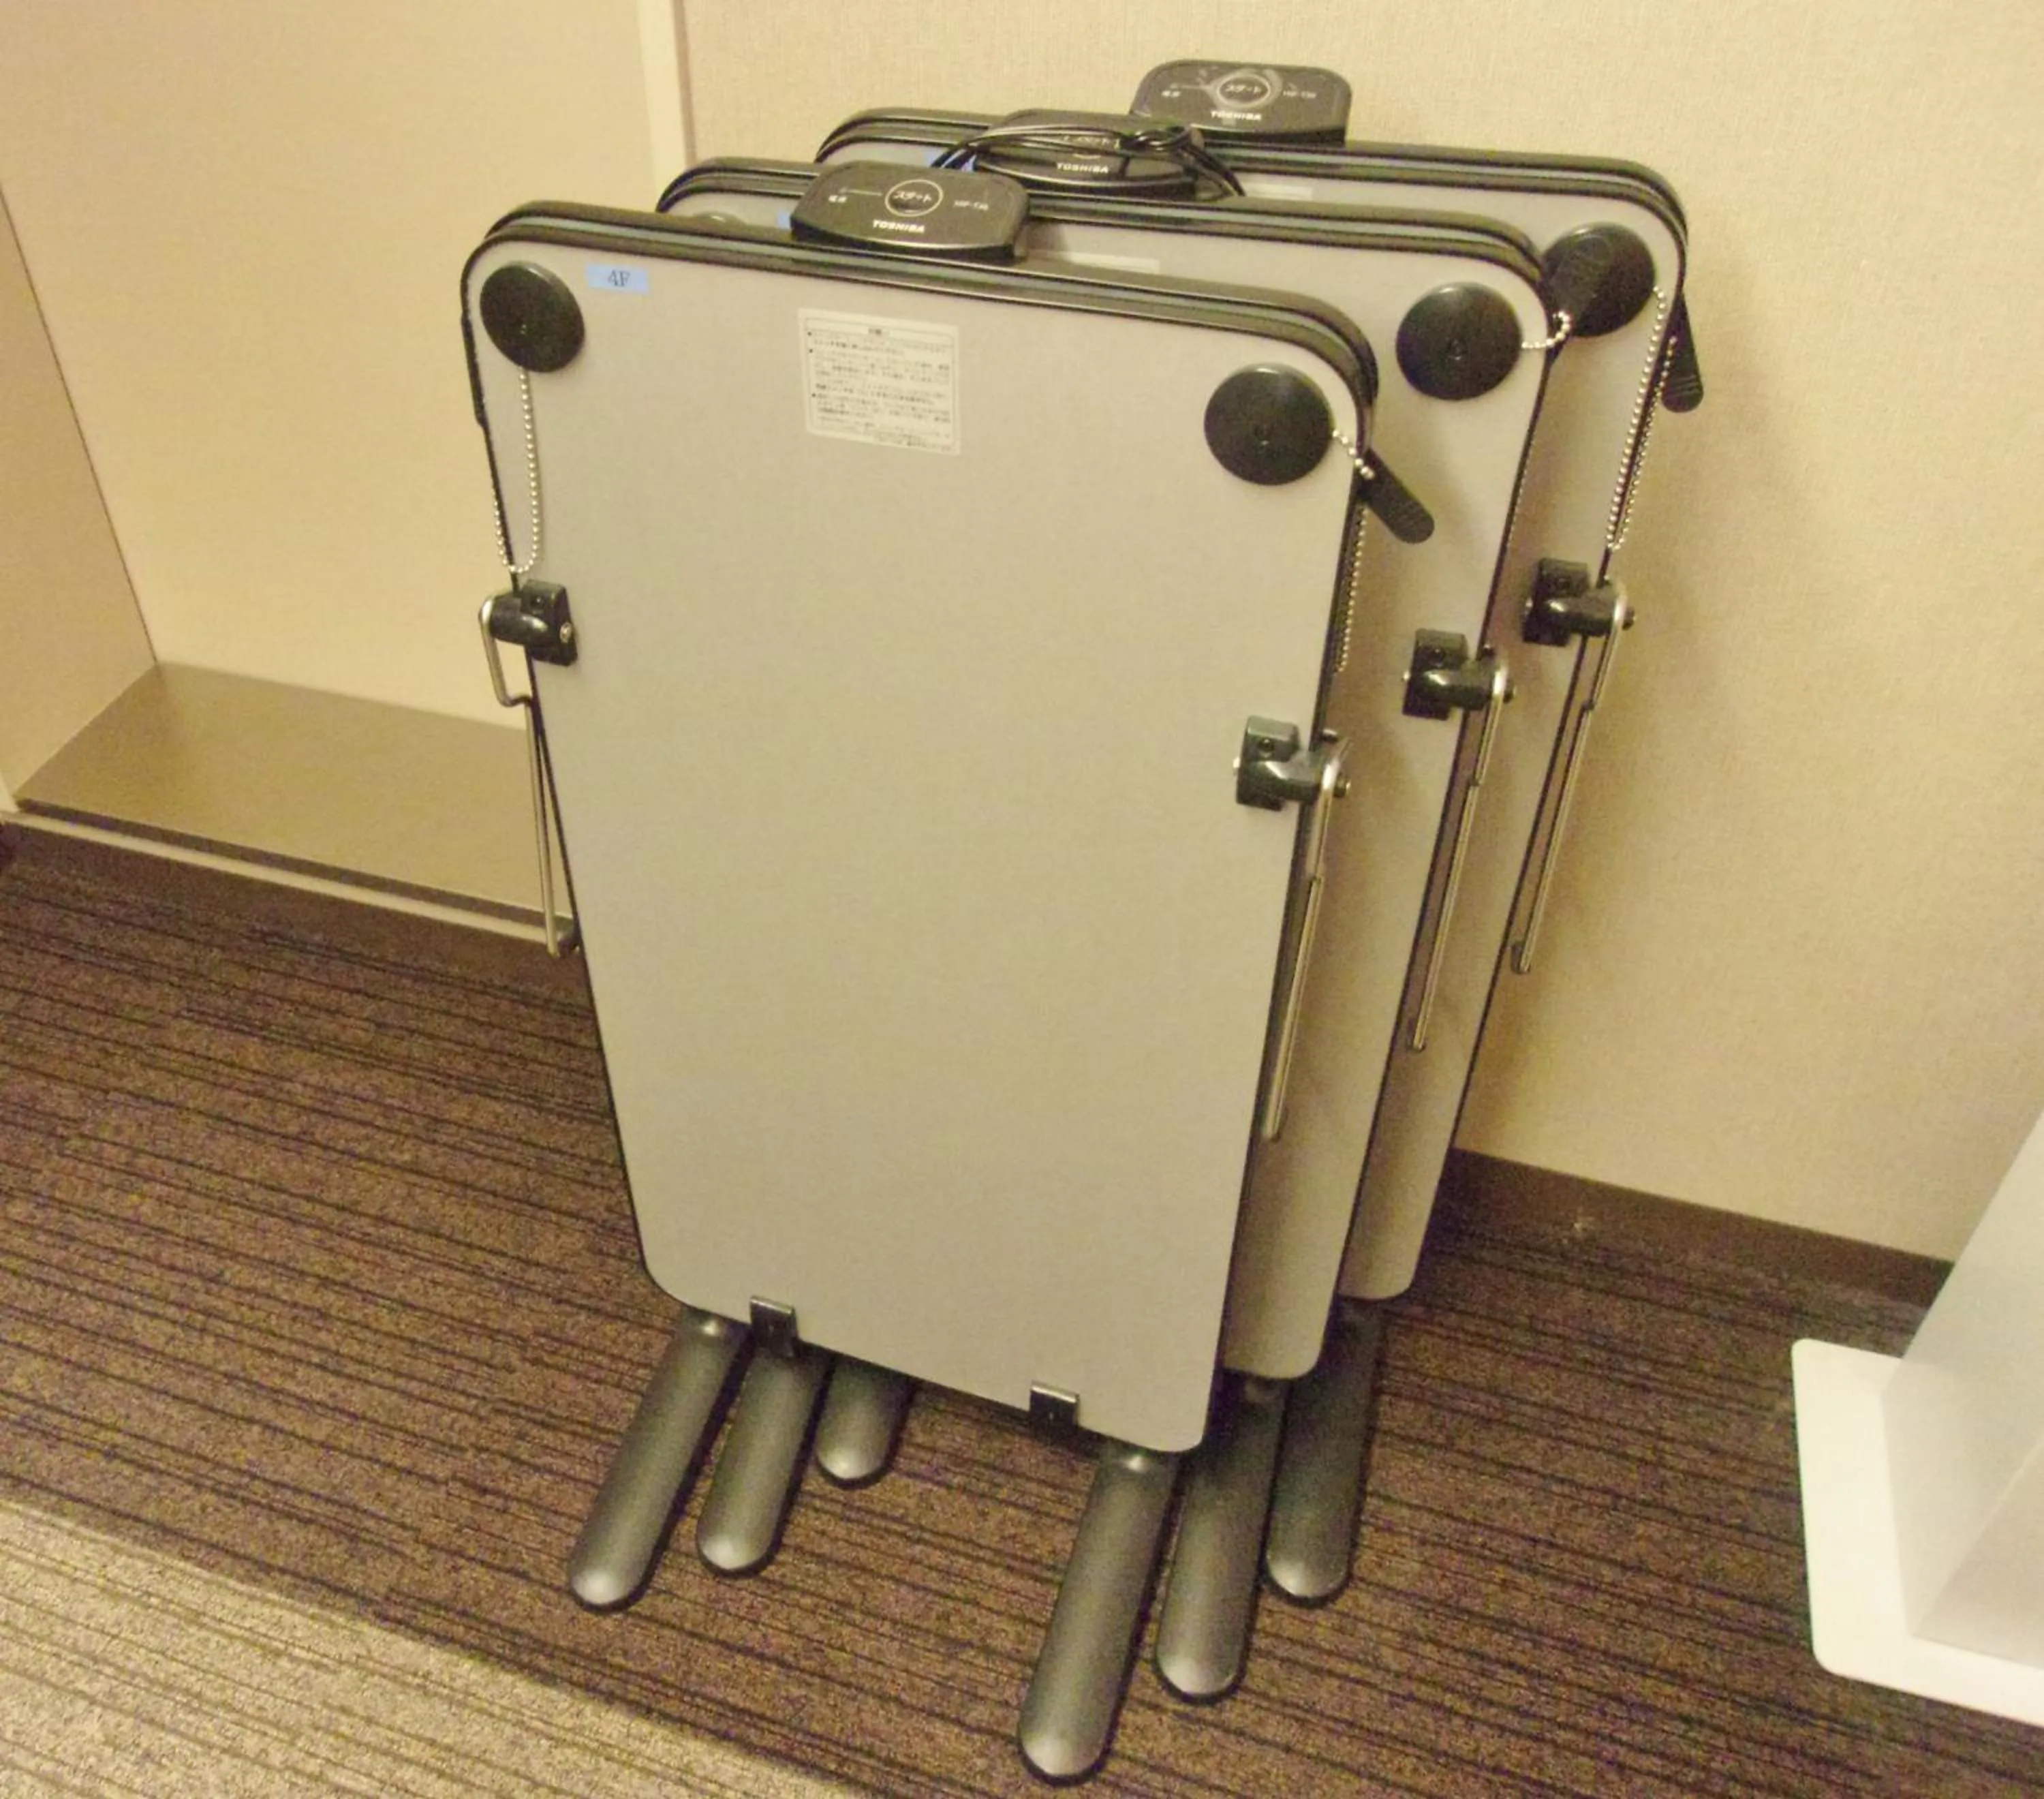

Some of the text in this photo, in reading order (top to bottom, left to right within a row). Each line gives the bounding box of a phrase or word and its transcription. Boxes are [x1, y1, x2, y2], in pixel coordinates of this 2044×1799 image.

[1211, 110, 1262, 121] TOSHIBA
[1056, 162, 1109, 174] TOSHIBA
[893, 190, 933, 204] スタート
[872, 219, 925, 233] TOSHIBA
[607, 269, 631, 287] 4F
